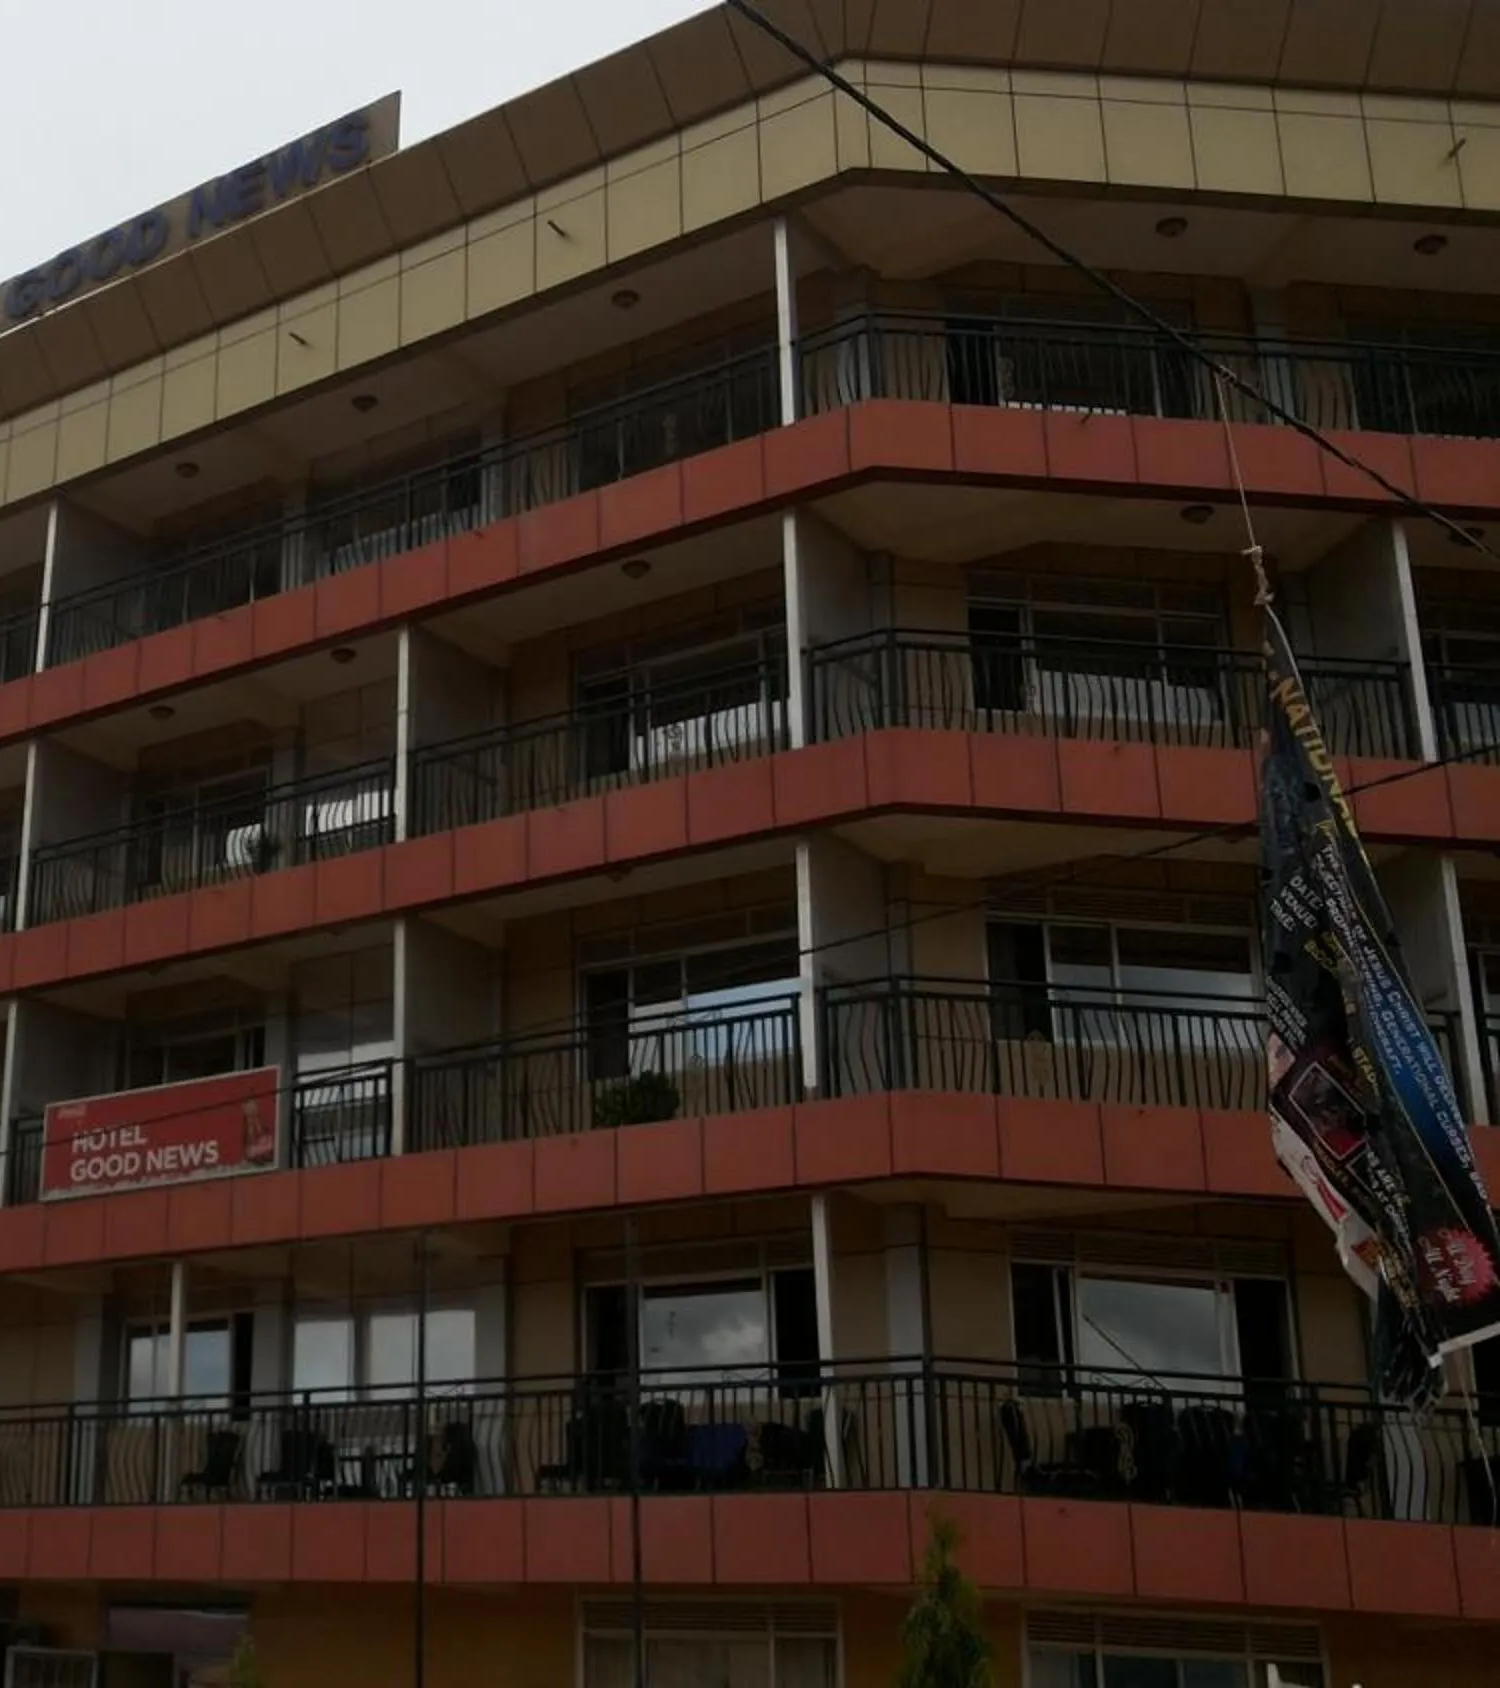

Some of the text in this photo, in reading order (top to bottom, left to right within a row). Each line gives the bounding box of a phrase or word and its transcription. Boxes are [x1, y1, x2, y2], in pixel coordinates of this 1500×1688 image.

[7, 212, 169, 318] GOOD
[189, 113, 370, 239] NEWS
[72, 1124, 148, 1153] HOTEL
[70, 1151, 141, 1182] GOOD
[145, 1139, 219, 1172] NEWS
